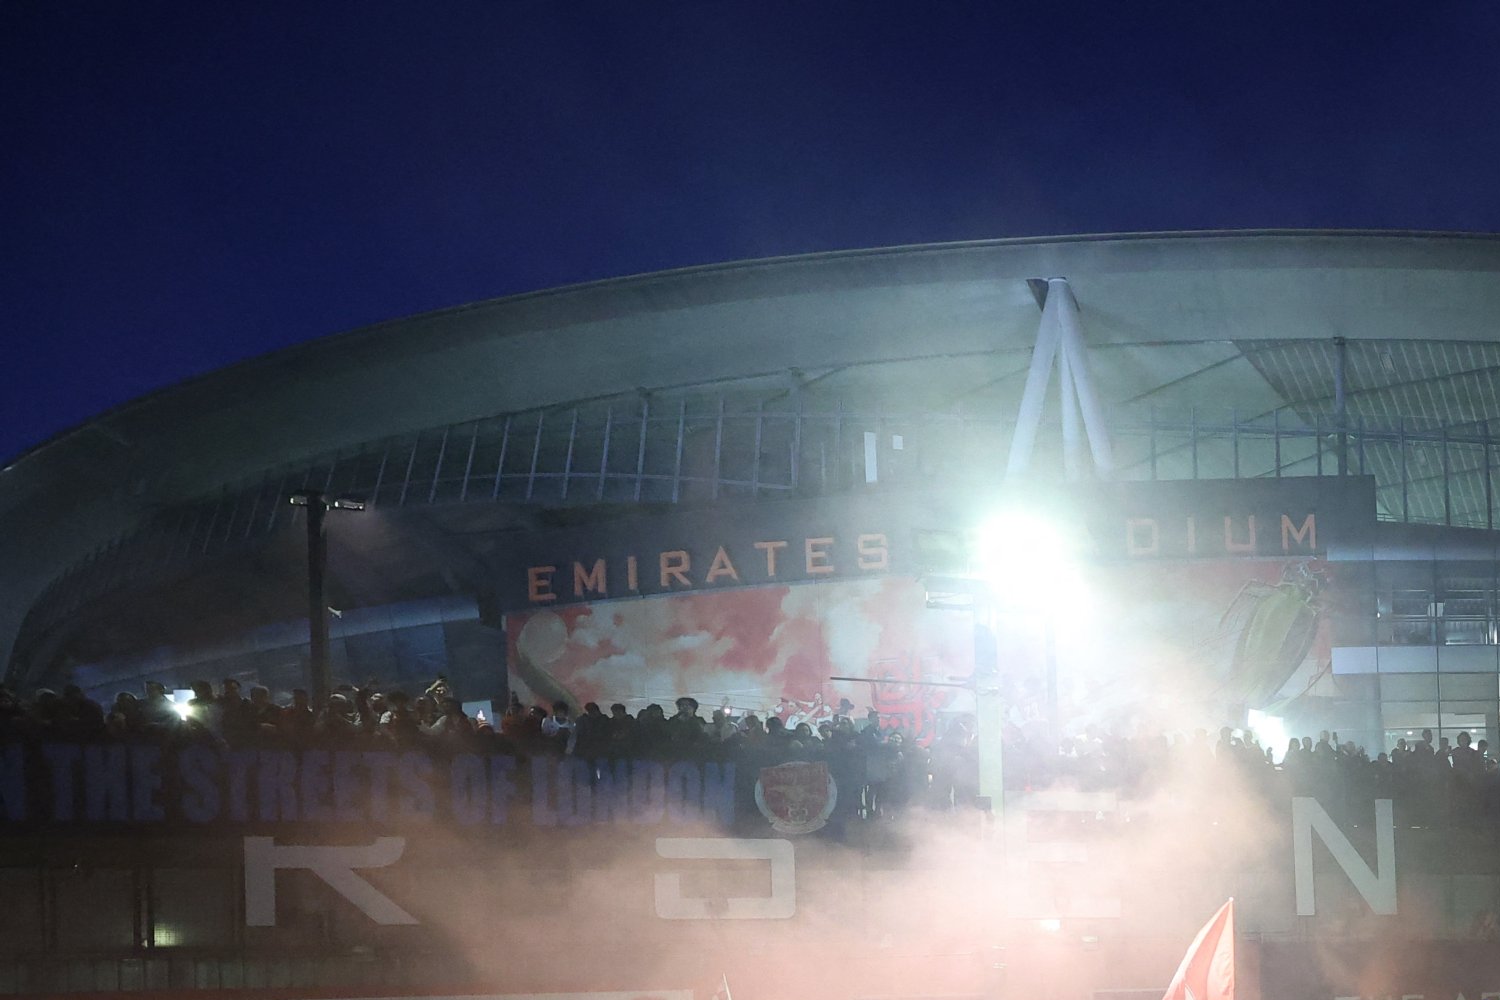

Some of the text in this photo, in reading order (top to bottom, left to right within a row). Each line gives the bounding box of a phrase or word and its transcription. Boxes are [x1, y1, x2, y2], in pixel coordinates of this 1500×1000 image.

[528, 513, 1319, 602] EMIRATES DIUM
[41, 743, 165, 822] THE
[178, 744, 435, 825] STREETS
[451, 752, 516, 825] OF
[531, 754, 735, 826] LONDON
